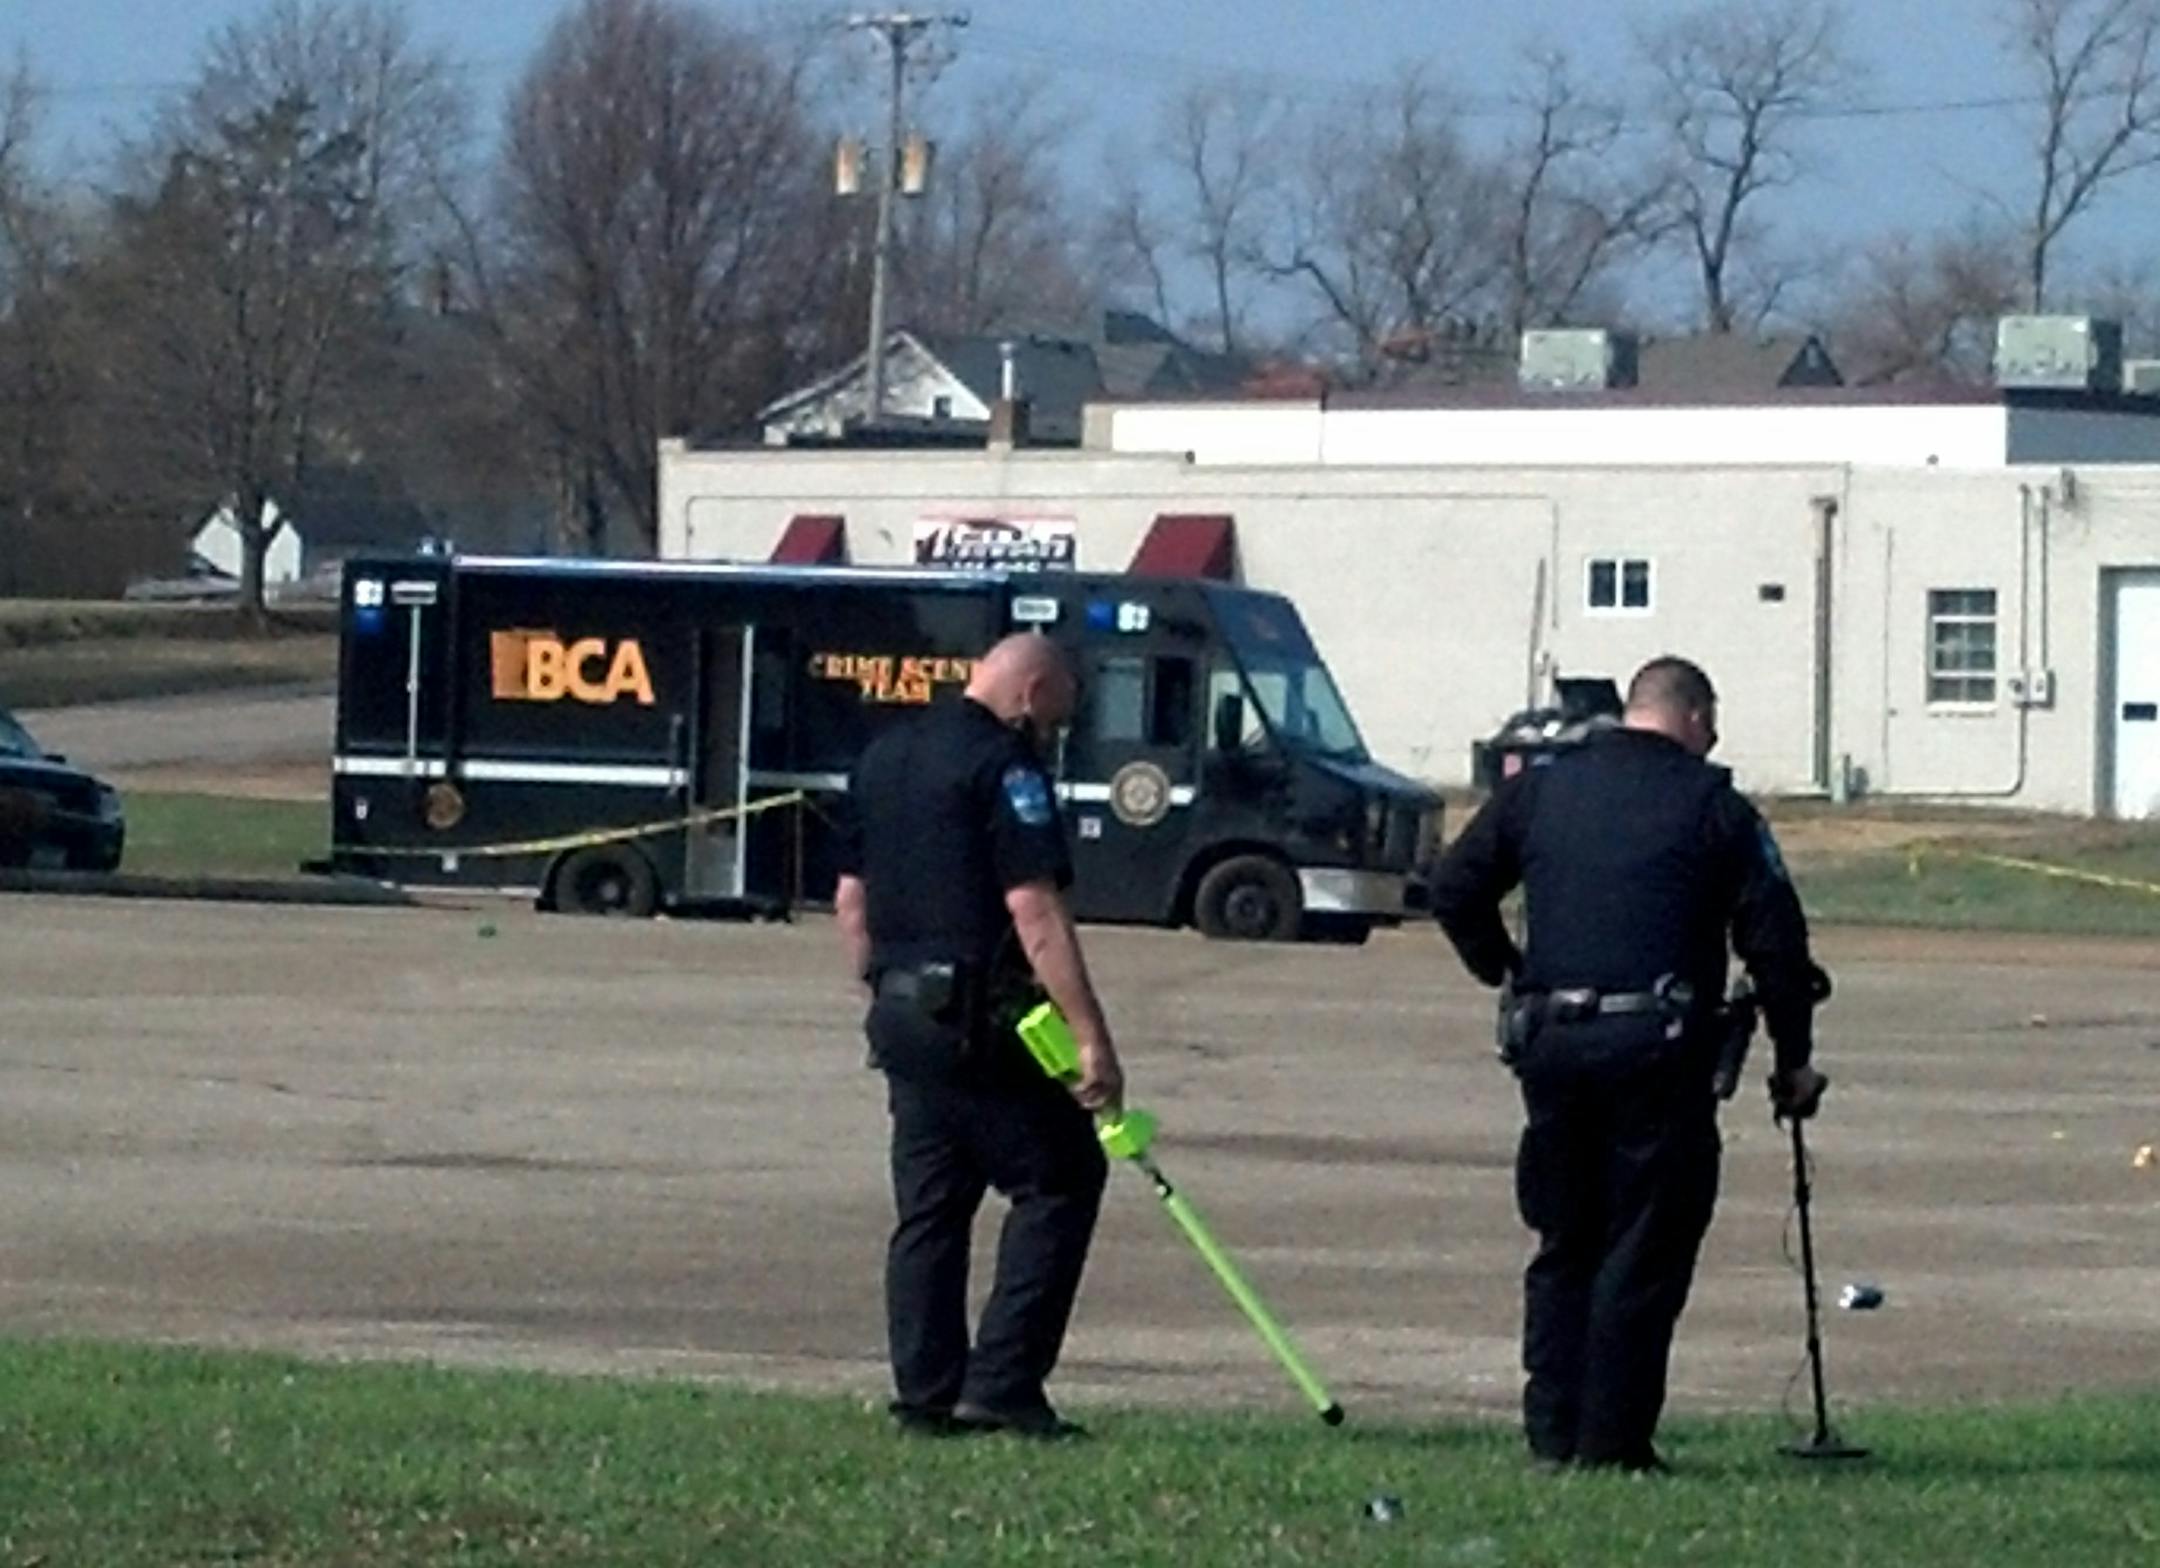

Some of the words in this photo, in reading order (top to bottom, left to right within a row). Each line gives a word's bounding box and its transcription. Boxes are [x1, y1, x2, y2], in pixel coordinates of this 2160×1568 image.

[526, 637, 655, 705] BCA
[808, 654, 892, 679] CRIME
[860, 679, 931, 703] TEAM
